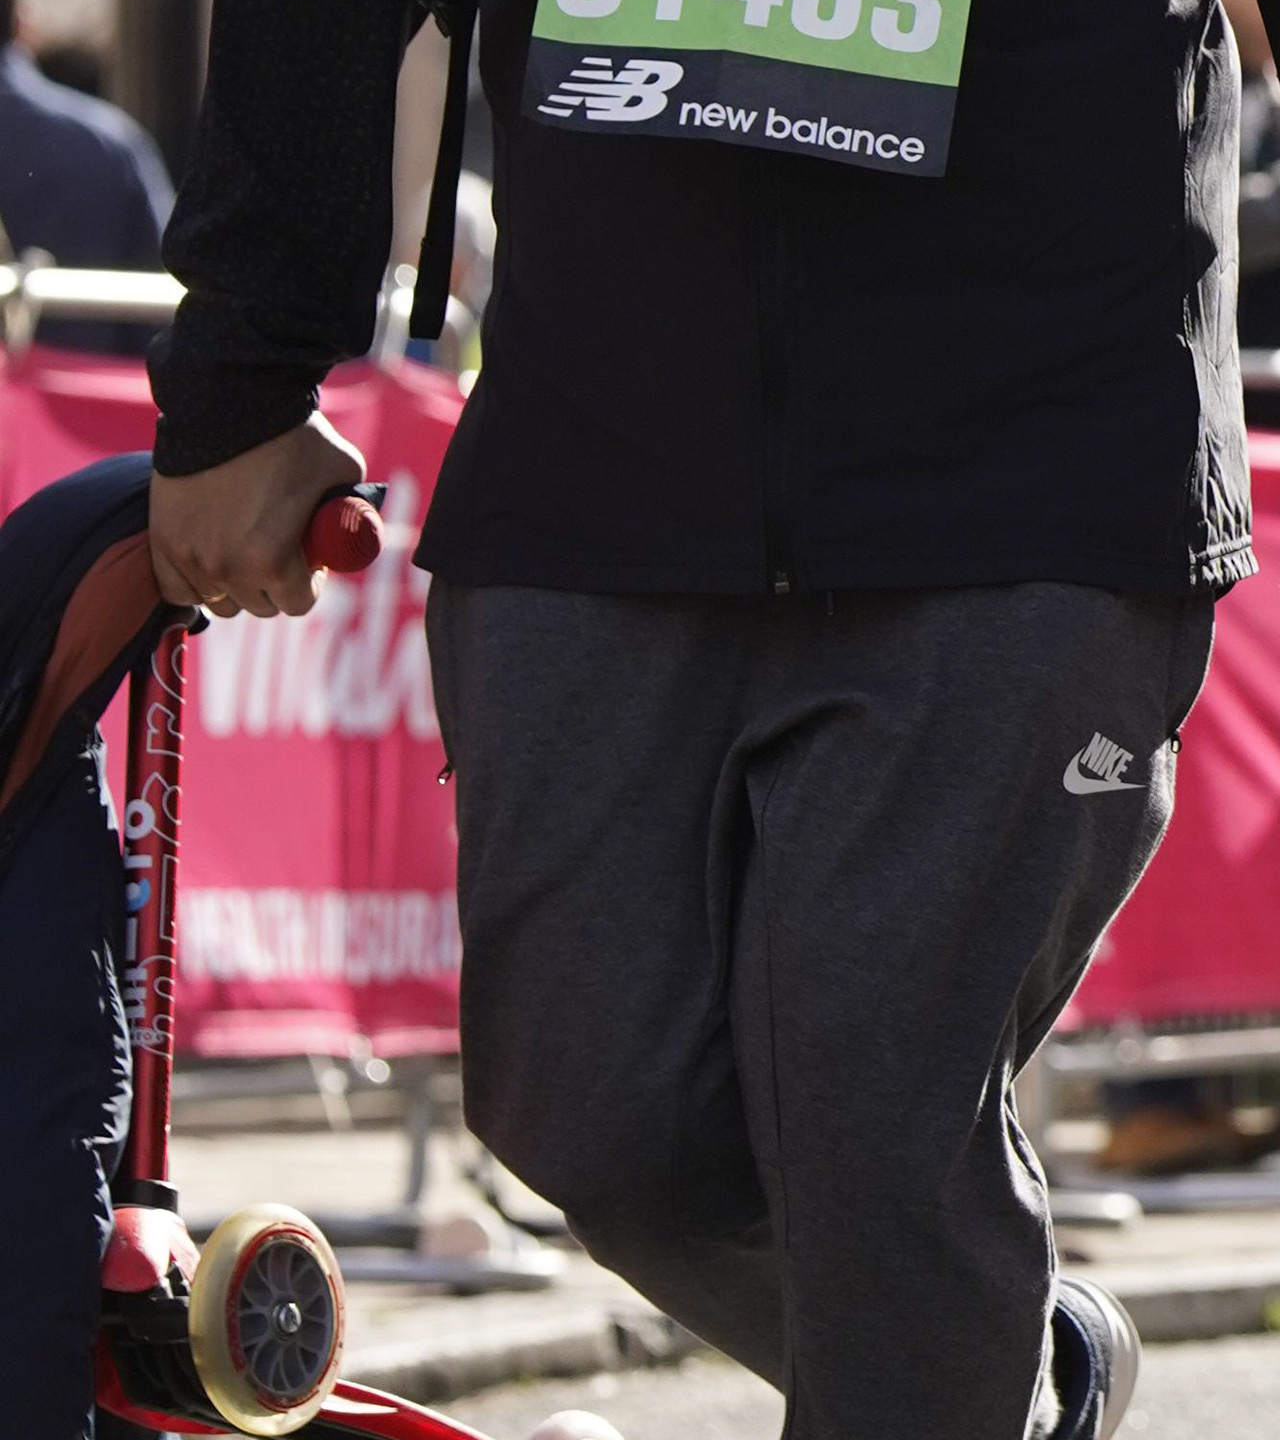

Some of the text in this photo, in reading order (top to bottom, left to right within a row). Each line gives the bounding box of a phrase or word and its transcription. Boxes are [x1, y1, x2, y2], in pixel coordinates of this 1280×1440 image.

[679, 99, 758, 133] new
[765, 107, 925, 163] balance
[1080, 731, 1134, 783] NIKE
